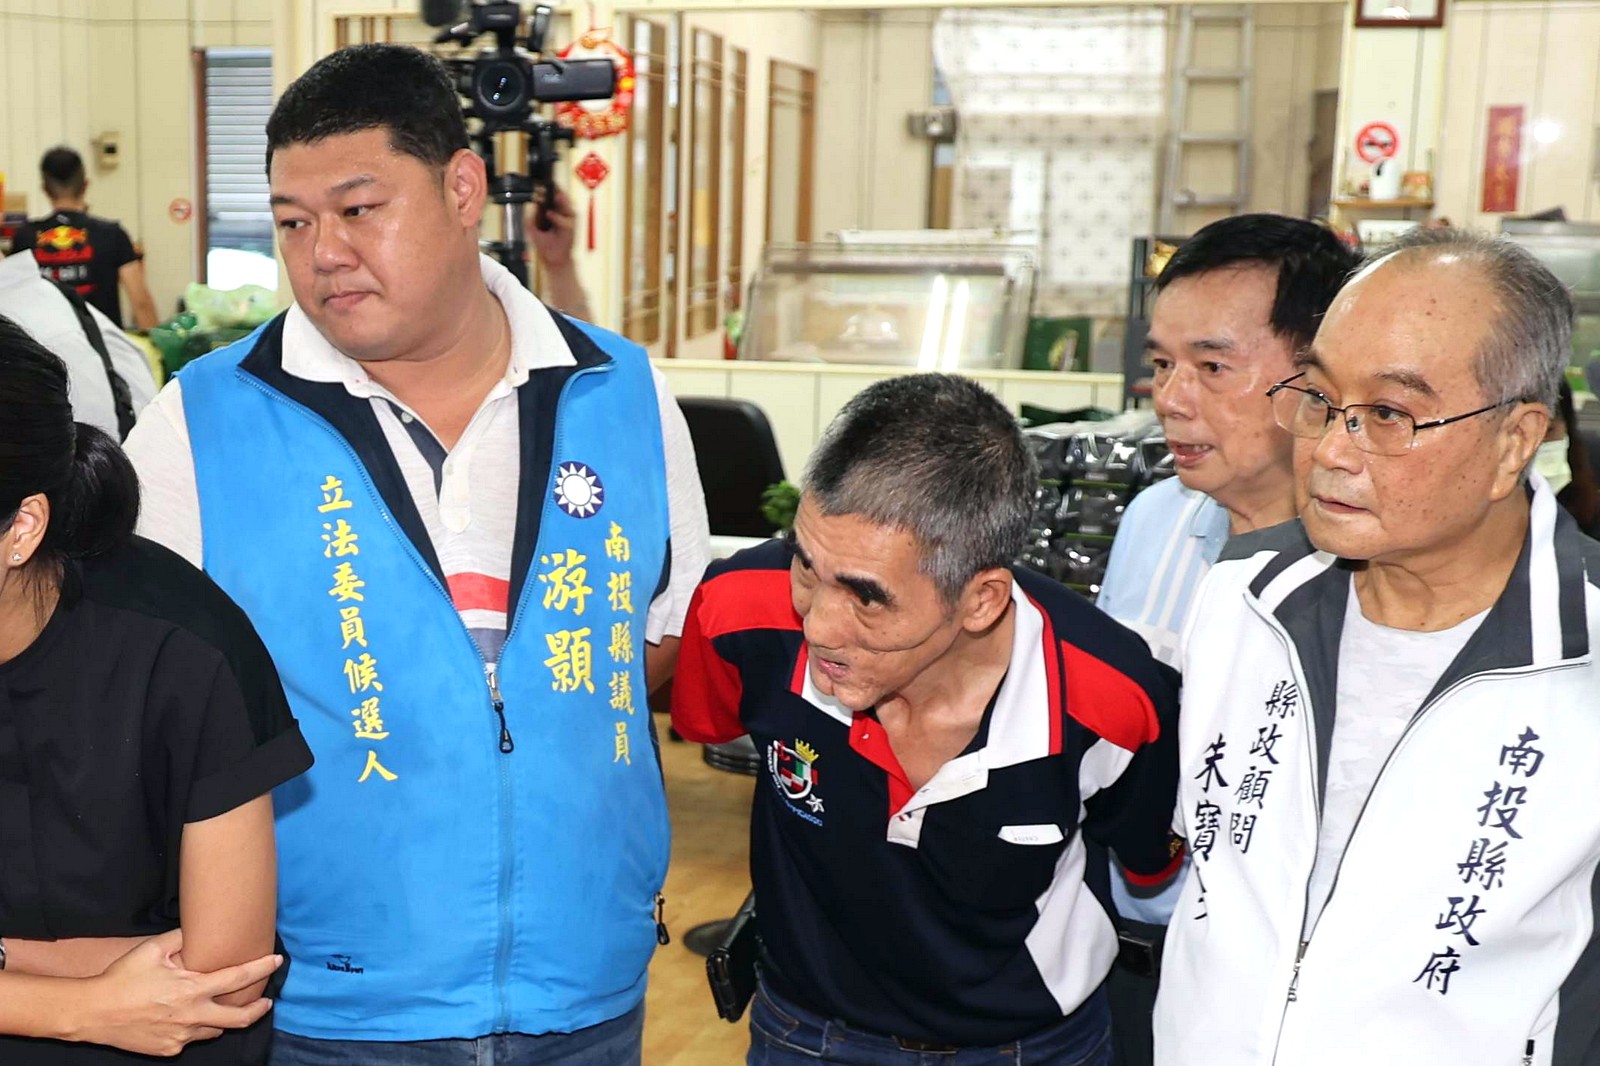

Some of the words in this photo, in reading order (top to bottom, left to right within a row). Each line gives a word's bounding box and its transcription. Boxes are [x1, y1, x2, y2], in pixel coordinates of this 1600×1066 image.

[317, 475, 398, 783] 立法委員候選人
[539, 548, 596, 696] 游顥
[604, 521, 636, 767] 南投縣議員
[1192, 733, 1229, 920] 朱寶
[1229, 680, 1297, 854] 縣政顧問
[1412, 726, 1545, 995] 南投縣政府
